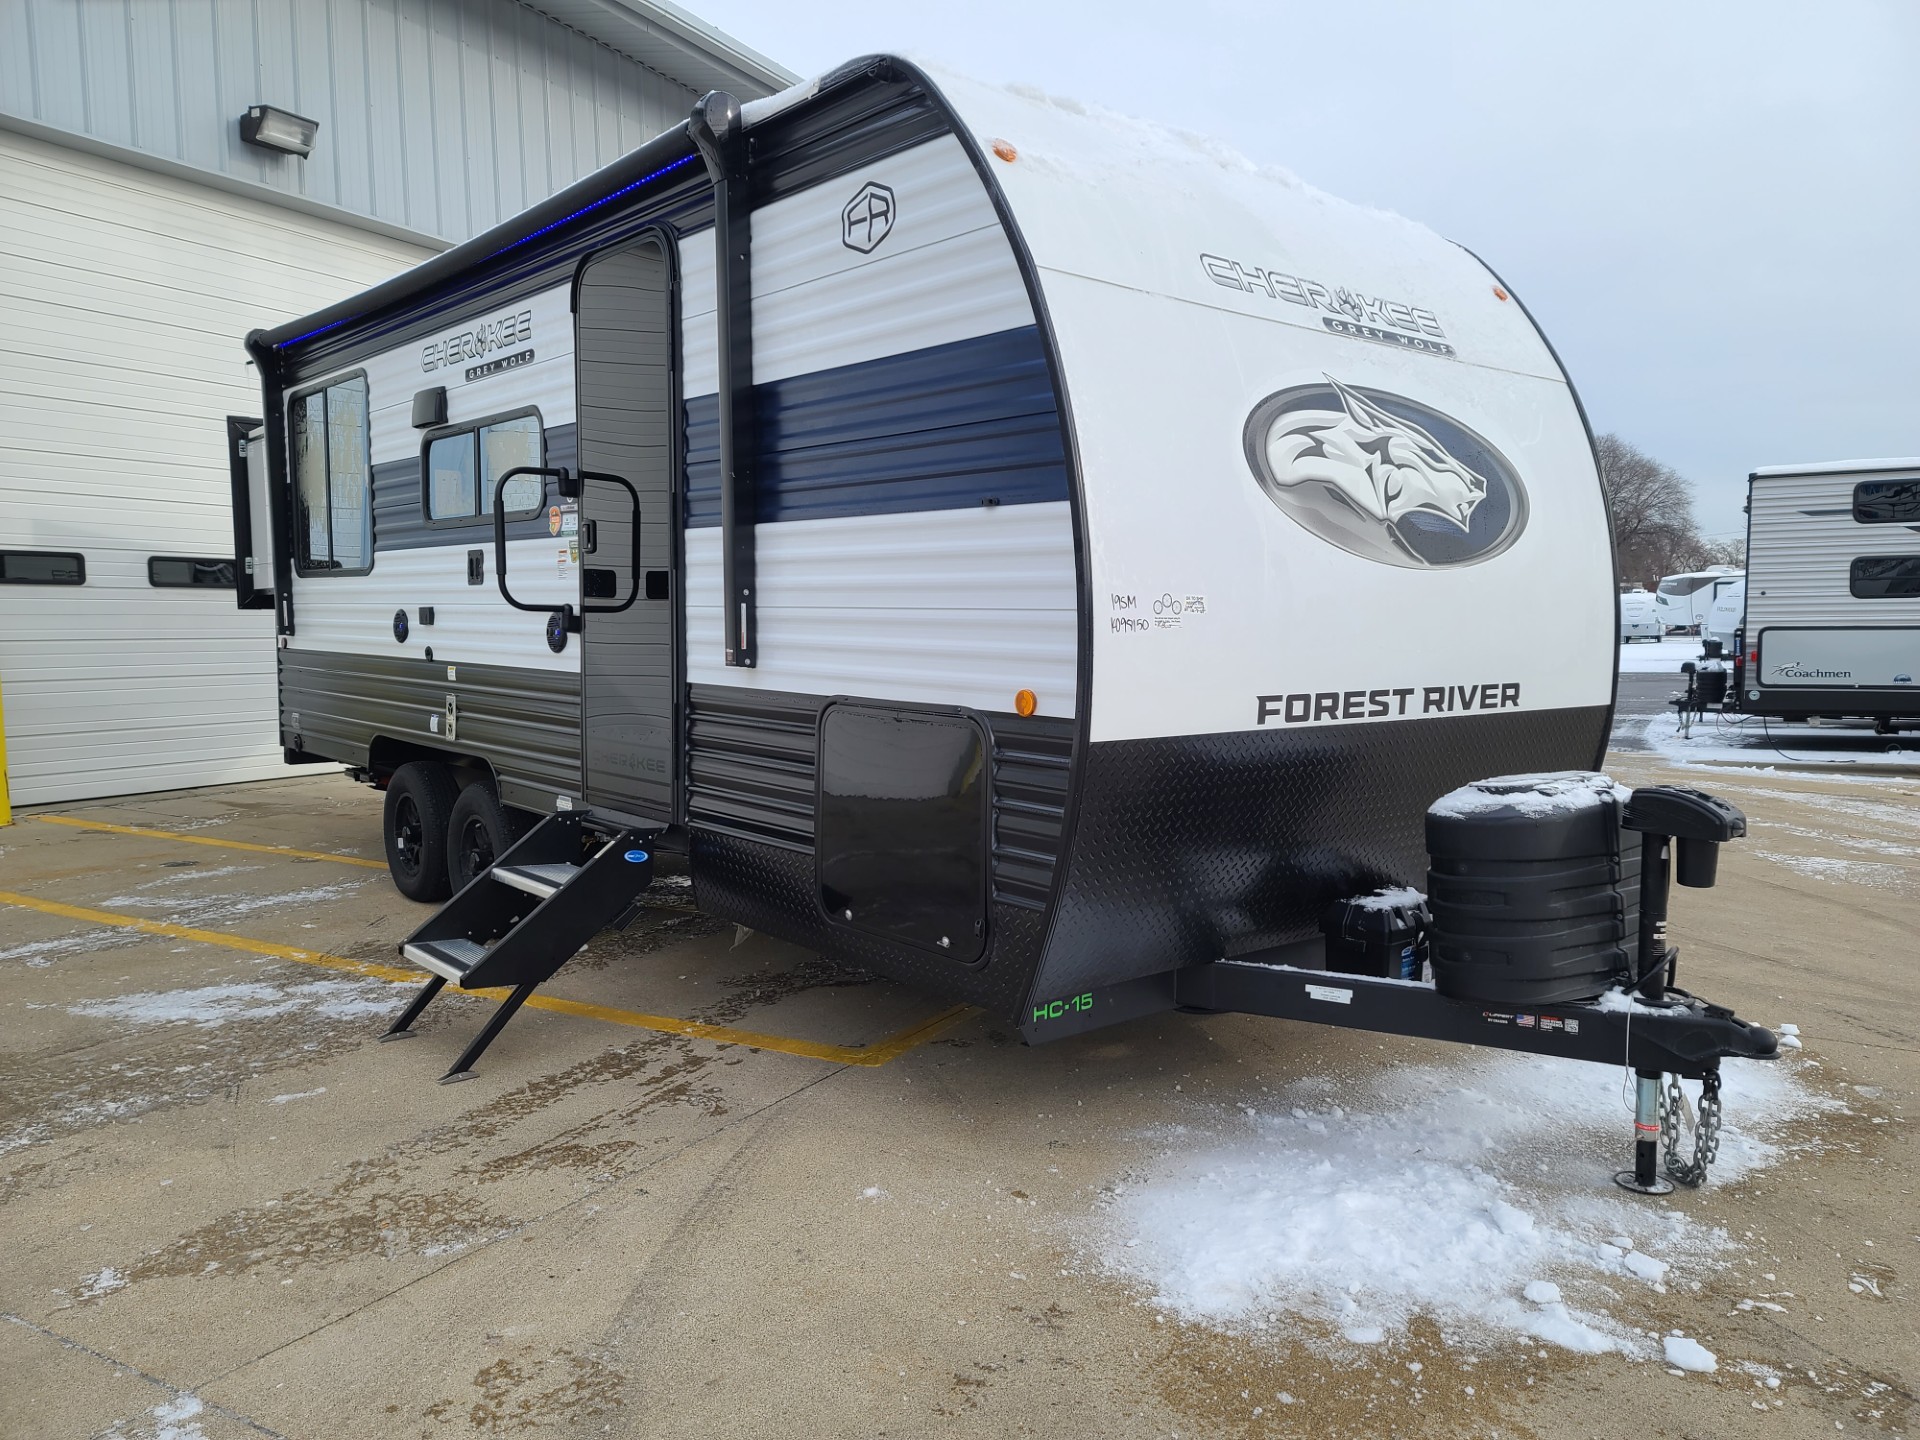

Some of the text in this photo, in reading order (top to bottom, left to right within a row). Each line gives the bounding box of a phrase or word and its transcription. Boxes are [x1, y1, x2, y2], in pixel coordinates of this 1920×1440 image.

[1199, 253, 1446, 339] CHEROKEE
[421, 310, 532, 373] CHEROKEE
[1332, 320, 1449, 354] GREY WOLF
[469, 352, 532, 379] GREY WOLF
[1785, 668, 1852, 679] Coachmen
[1256, 682, 1520, 726] FOREST RIVER
[1033, 992, 1093, 1023] HC-15
